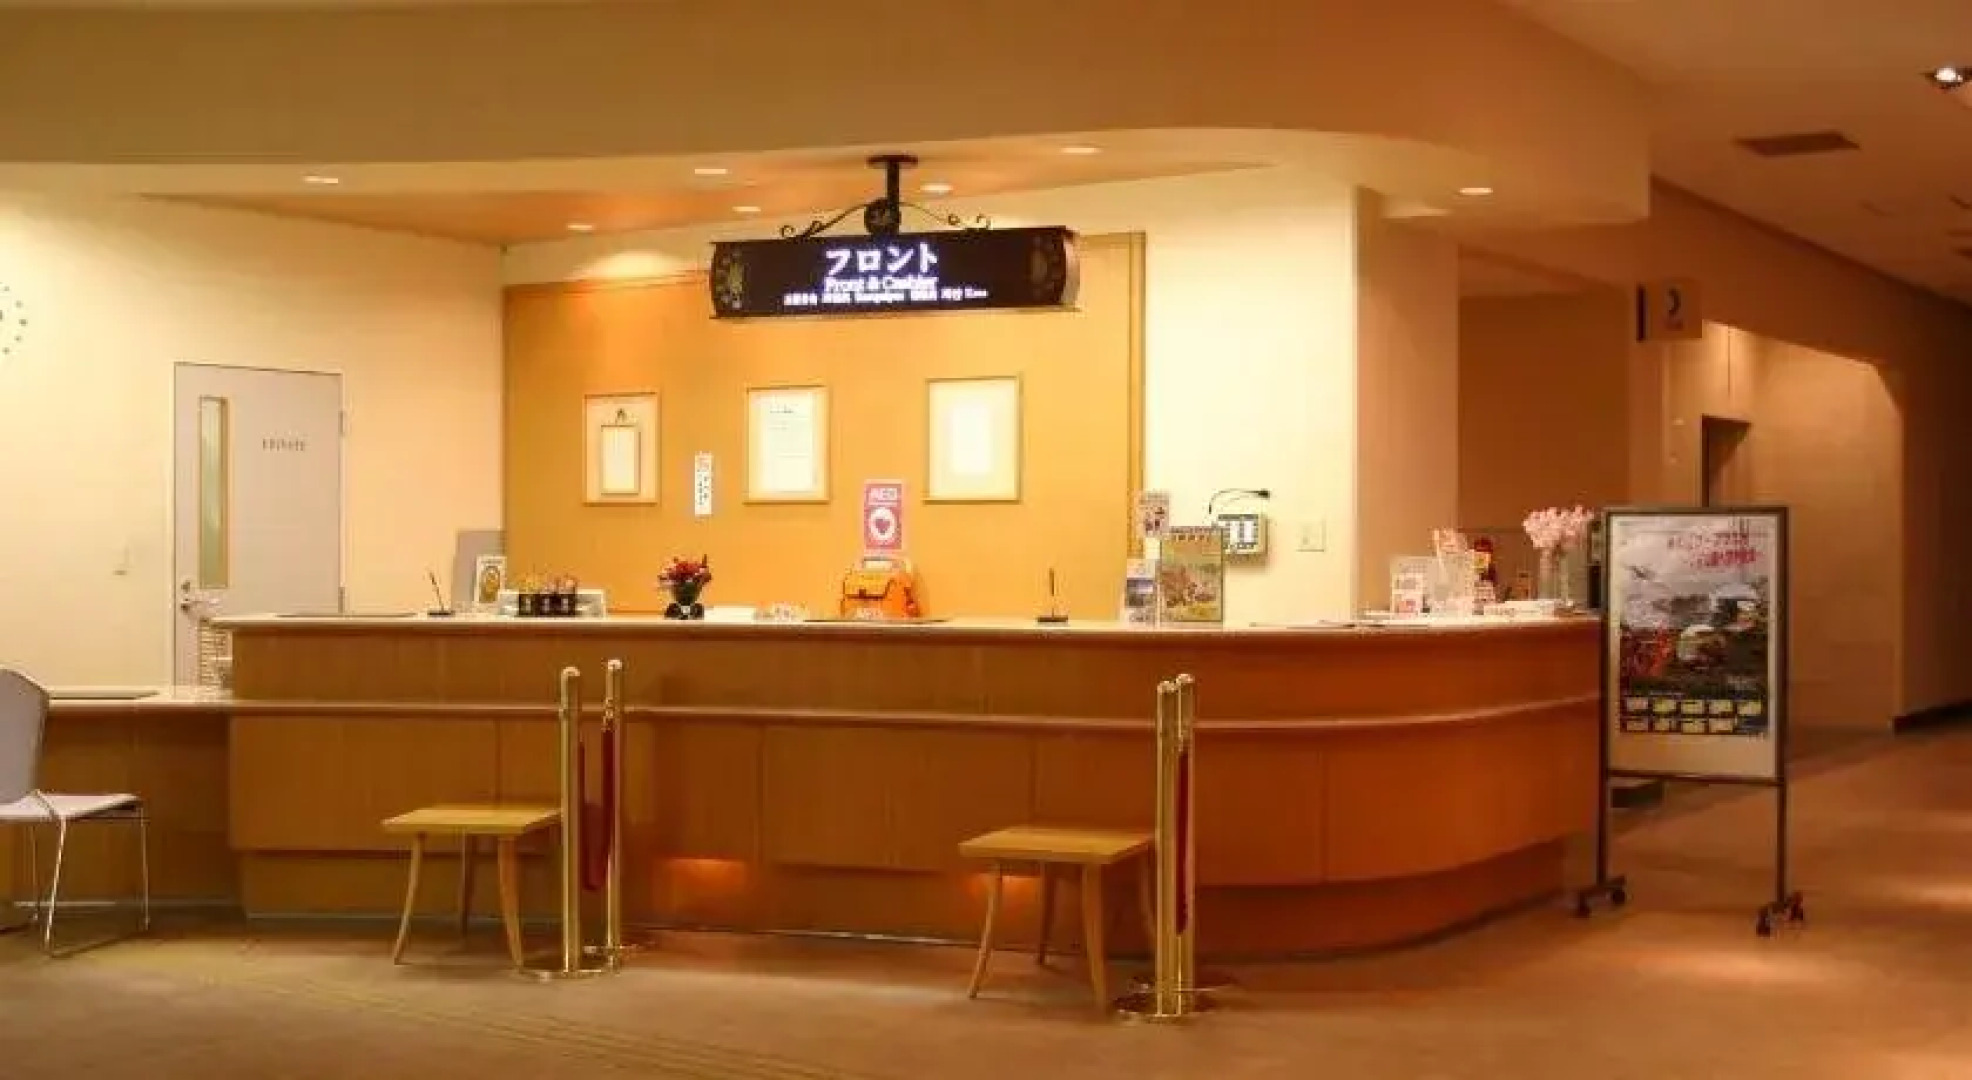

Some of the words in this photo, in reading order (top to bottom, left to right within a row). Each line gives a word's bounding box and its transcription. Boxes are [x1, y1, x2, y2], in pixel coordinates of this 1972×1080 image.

[825, 242, 938, 276] フロント
[869, 487, 898, 501] AED
